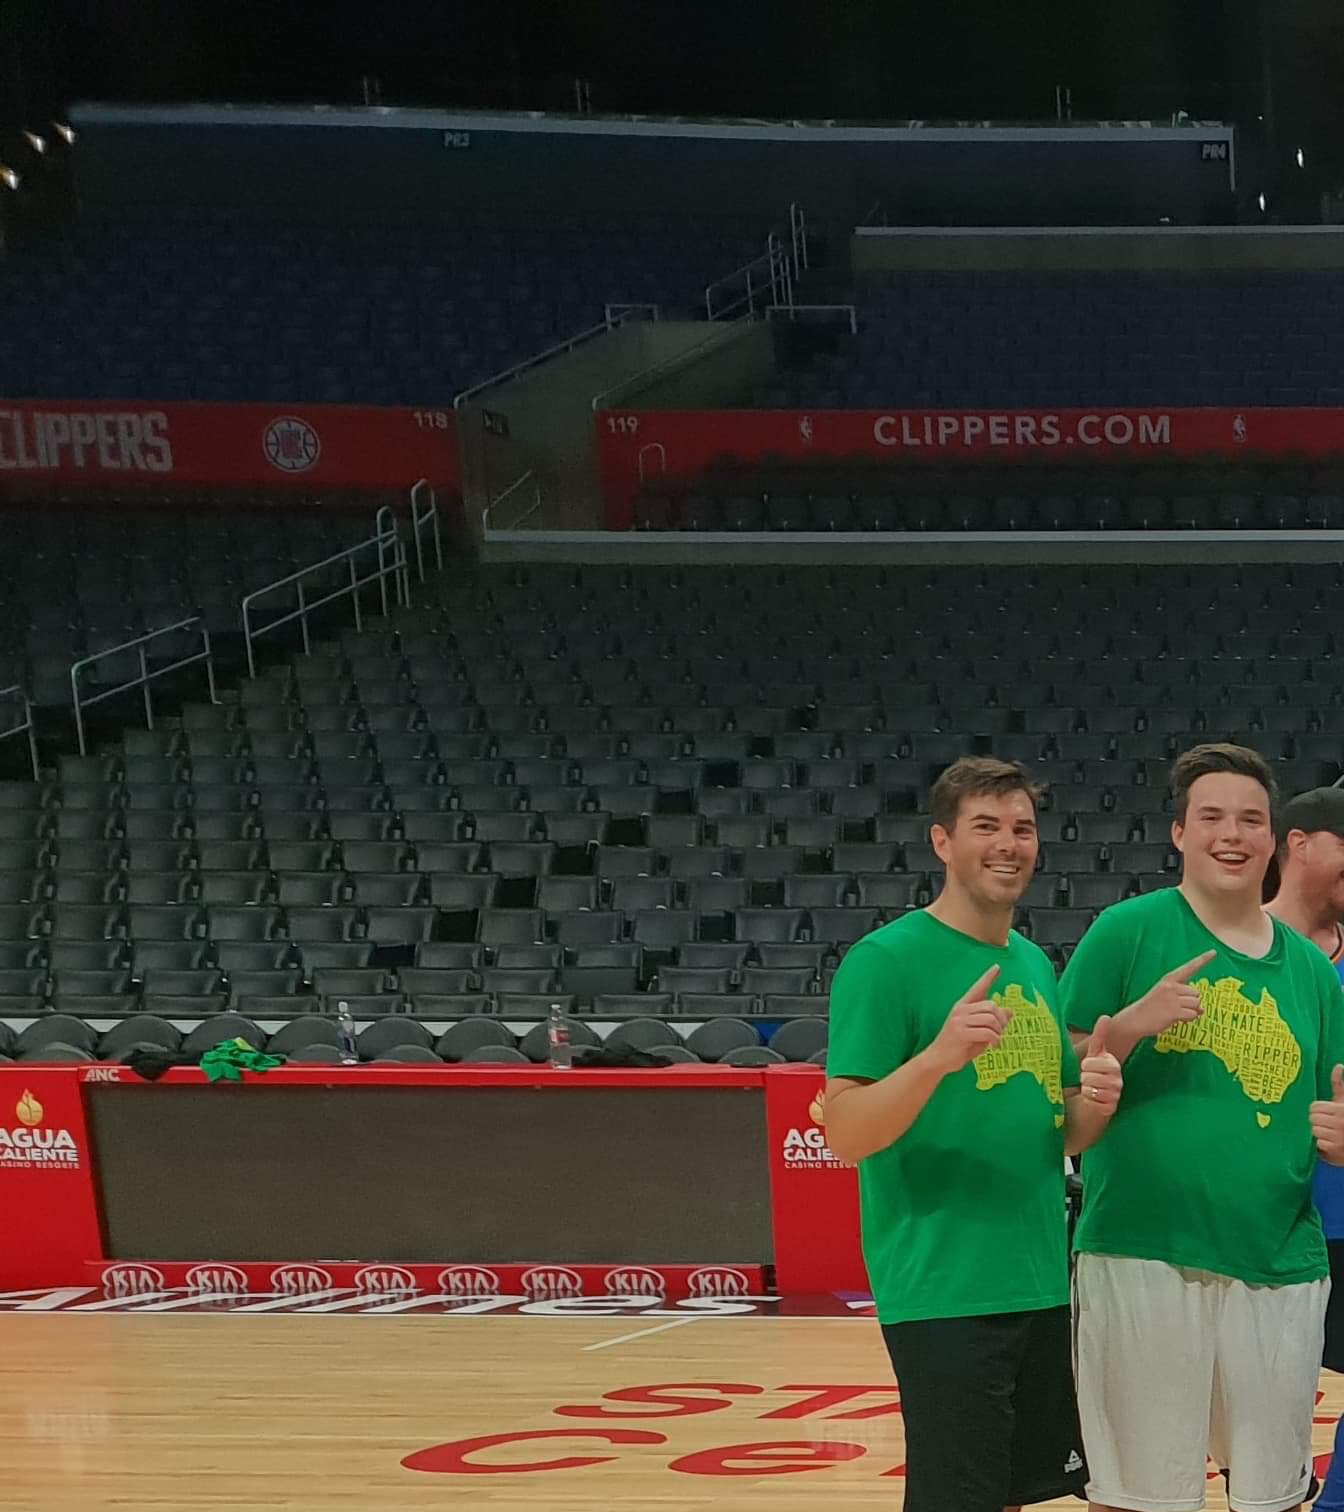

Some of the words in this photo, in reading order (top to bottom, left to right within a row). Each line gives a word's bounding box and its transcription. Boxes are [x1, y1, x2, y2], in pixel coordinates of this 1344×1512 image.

[608, 415, 639, 433] 119
[873, 414, 1171, 446] CLIPPERS.COM
[1231, 1008, 1266, 1034] MATE
[1243, 1041, 1300, 1070] RIPPER
[84, 1069, 120, 1081] ANC
[784, 1128, 825, 1148] AG
[0, 1147, 79, 1161] ALIENTE
[112, 1269, 154, 1290] KIA
[196, 1270, 238, 1290] KIA
[280, 1271, 322, 1291] KIA
[364, 1271, 407, 1292] KIA
[449, 1272, 490, 1292] KIA
[532, 1273, 573, 1292] KIA
[616, 1273, 655, 1293] KIA
[699, 1273, 739, 1295] KIA
